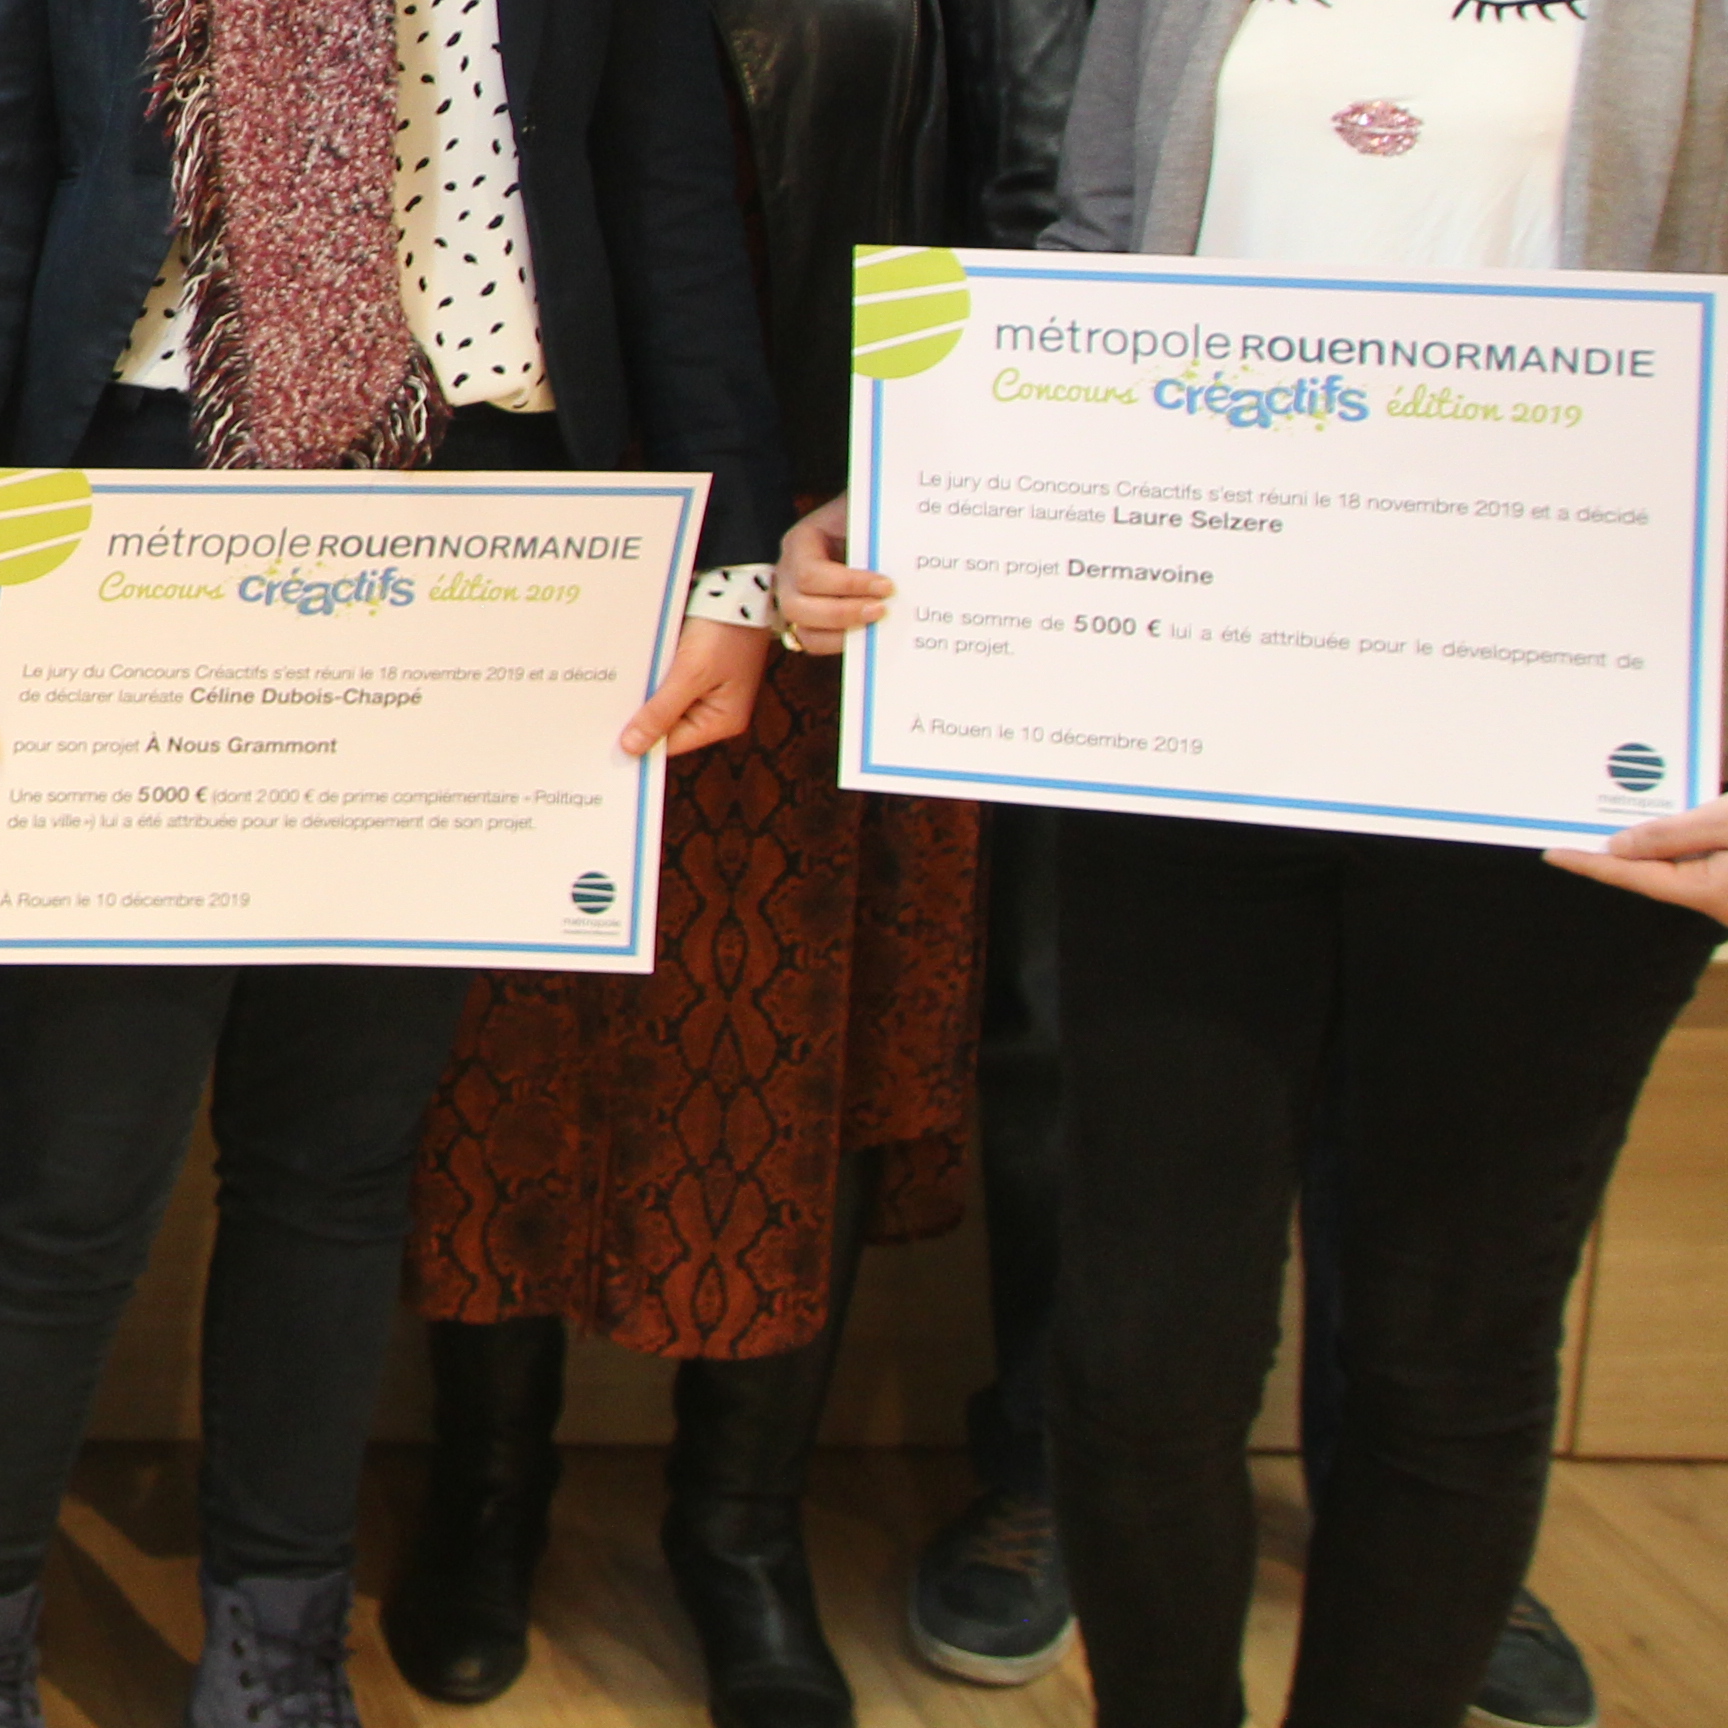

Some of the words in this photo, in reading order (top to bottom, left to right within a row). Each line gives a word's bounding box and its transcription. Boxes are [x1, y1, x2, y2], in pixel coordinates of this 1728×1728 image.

[995, 319, 1231, 365] métropole
[992, 367, 1138, 405] Concours
[1151, 372, 1370, 429] créactifs
[1386, 382, 1503, 422] édition
[1511, 402, 1583, 428] 2019
[1112, 504, 1183, 529] Laure
[1190, 507, 1283, 534] Selzere
[108, 526, 312, 565] métropole
[1066, 556, 1214, 585] Dermavoine
[99, 570, 225, 603] Concours
[237, 566, 416, 615] créactifs
[429, 570, 519, 602] édition
[526, 584, 581, 603] 2019
[189, 685, 255, 705] Céline
[260, 686, 422, 709] Dubois-Chappé
[144, 732, 161, 754] À
[166, 735, 221, 755] Nous
[226, 735, 337, 755] Grammont
